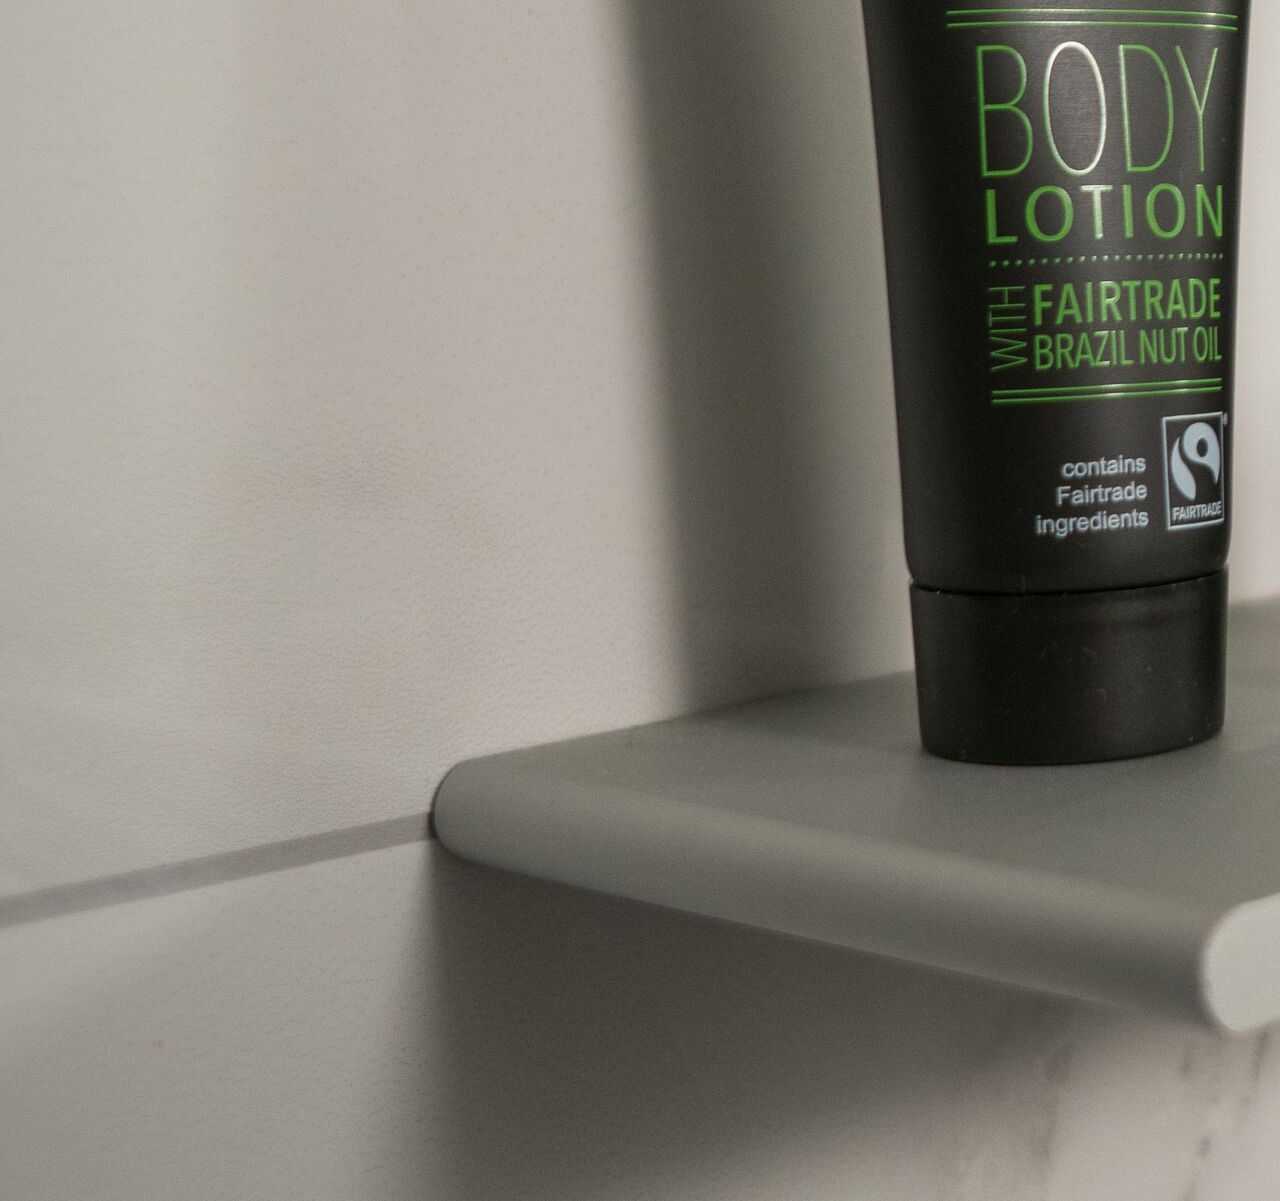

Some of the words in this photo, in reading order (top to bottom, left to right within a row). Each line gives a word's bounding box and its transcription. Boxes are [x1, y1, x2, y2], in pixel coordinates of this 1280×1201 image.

[976, 41, 1218, 176] BODY
[984, 183, 1222, 244] LOTION
[1033, 278, 1221, 326] FAIRTRADE
[988, 285, 1028, 372] WITH
[1033, 329, 1133, 370] BRAZIL
[1138, 327, 1189, 365] NUT
[1193, 326, 1222, 362] OIL
[1062, 454, 1146, 478] contains
[1056, 481, 1148, 506] Fairtrade
[1172, 501, 1222, 520] FAIRTRADE
[1036, 507, 1149, 539] ingredients
